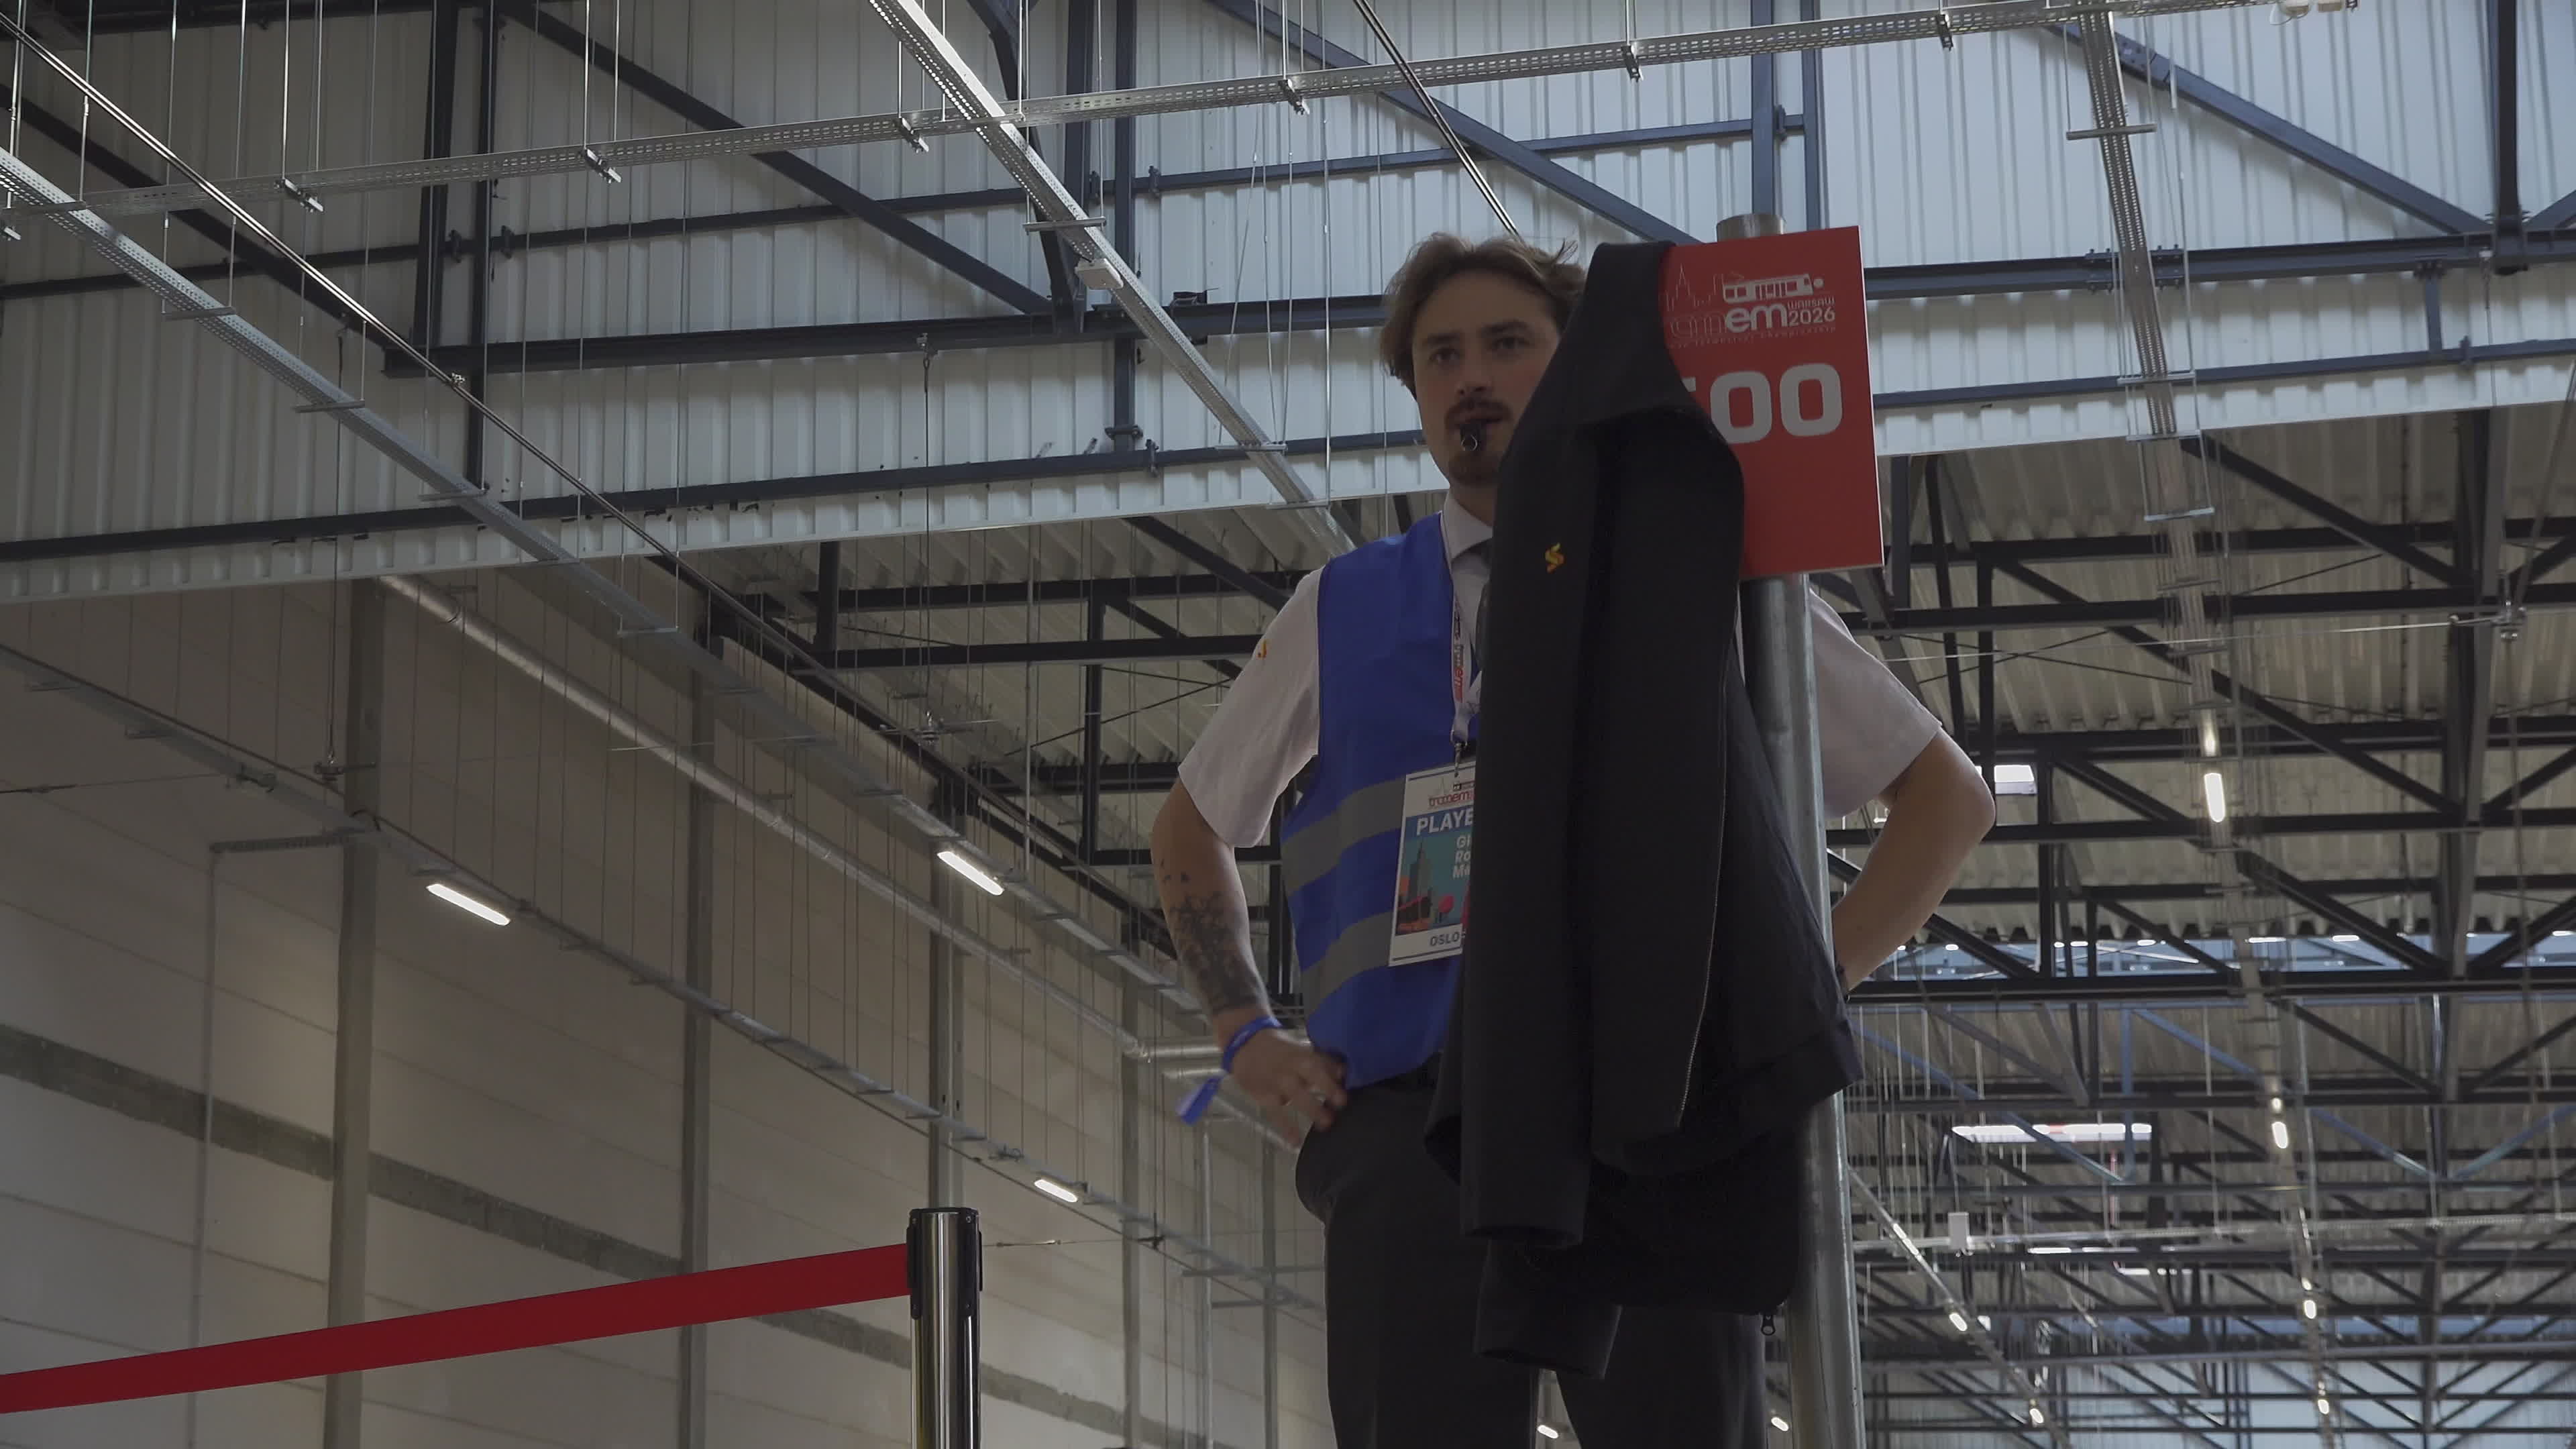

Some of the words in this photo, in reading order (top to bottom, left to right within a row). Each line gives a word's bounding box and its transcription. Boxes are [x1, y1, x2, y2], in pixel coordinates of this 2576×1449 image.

[1788, 307, 1836, 327] 2026
[1682, 363, 1843, 444] 00
[1416, 807, 1473, 835] PLAYE
[1455, 850, 1471, 864] Ro
[1430, 931, 1460, 947] OSLO
